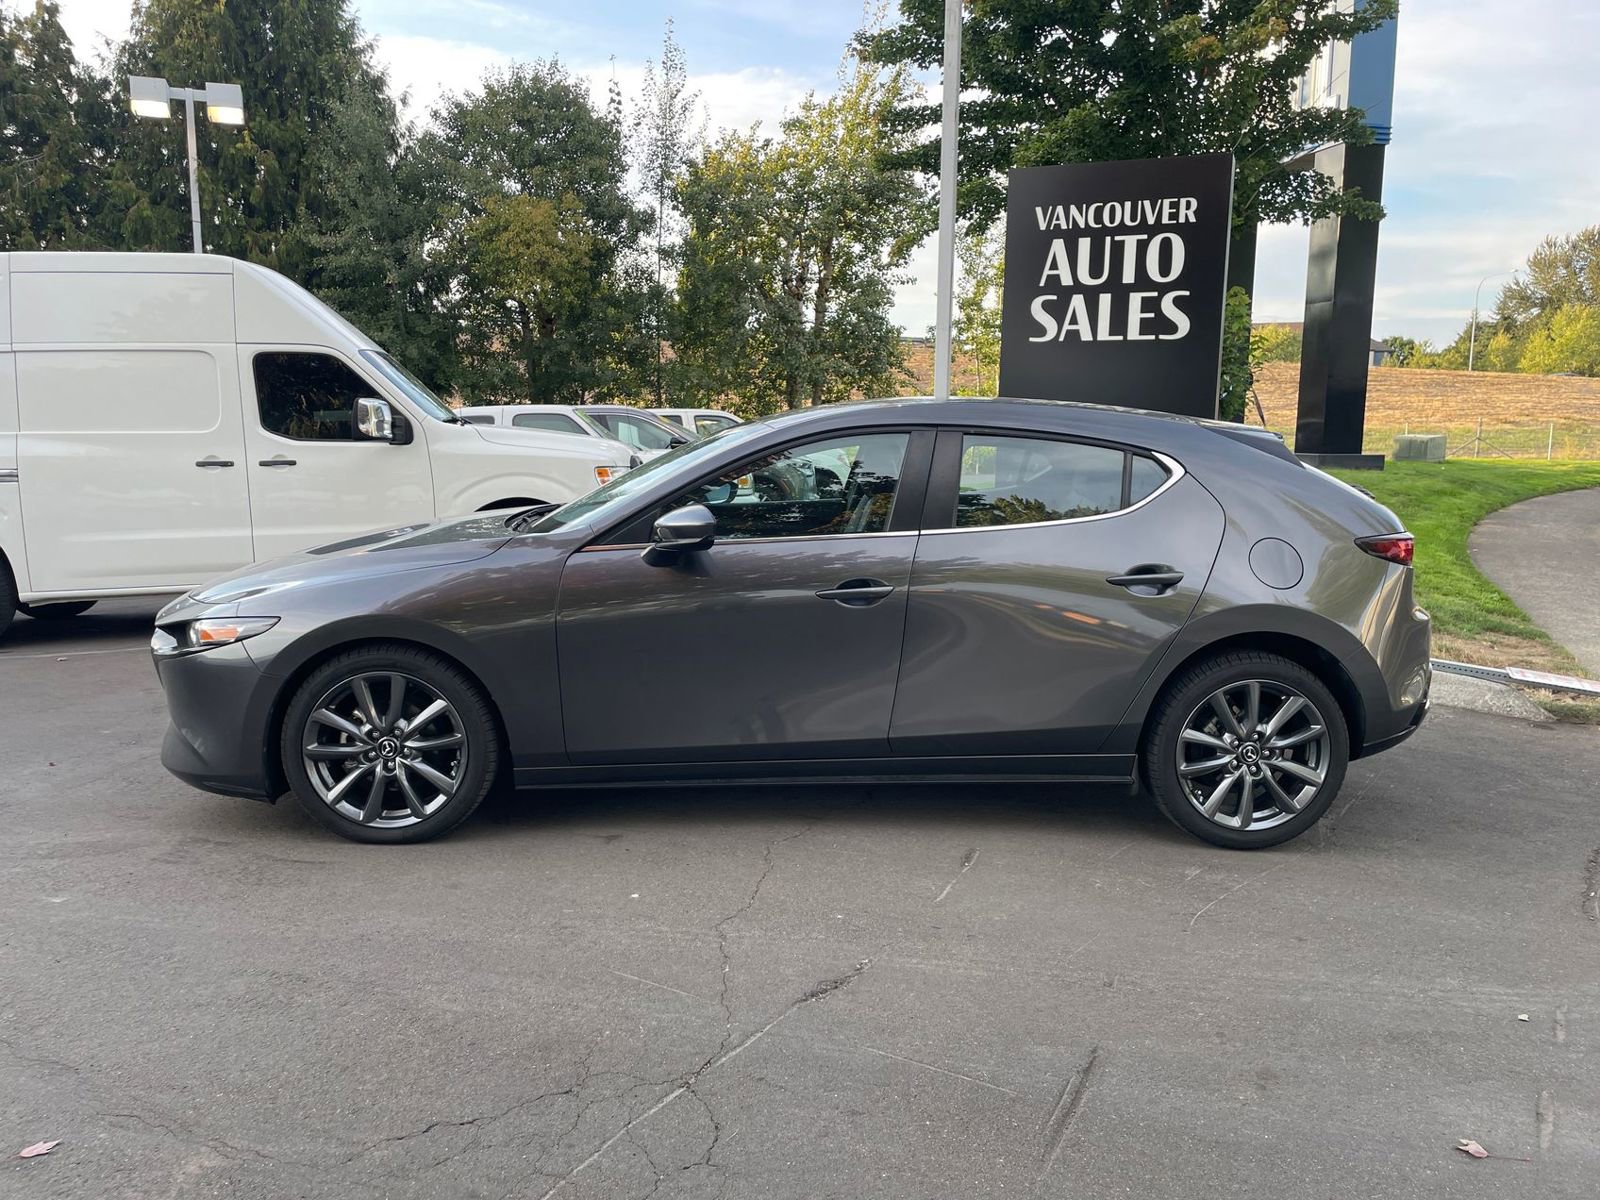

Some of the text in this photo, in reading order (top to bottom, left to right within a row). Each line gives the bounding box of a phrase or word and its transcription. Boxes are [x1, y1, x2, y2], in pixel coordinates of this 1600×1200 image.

[1035, 197, 1198, 231] VANCOUVER
[1039, 232, 1186, 287] AUTO
[1028, 290, 1191, 342] SALES
